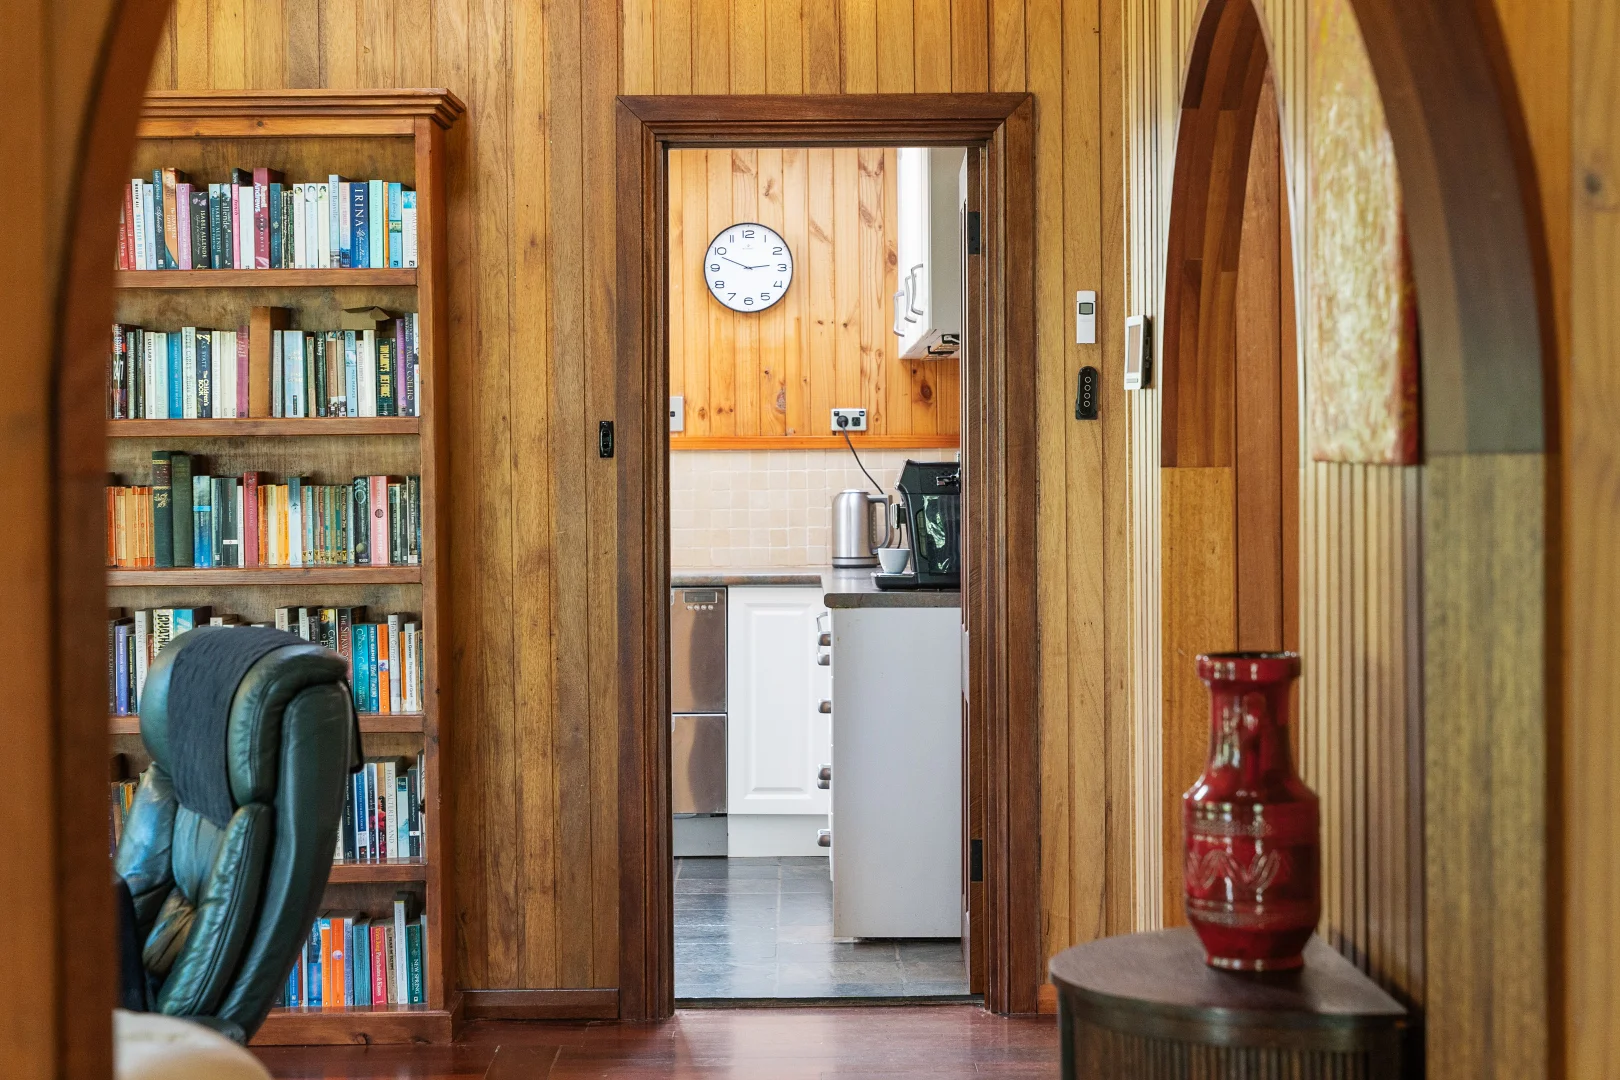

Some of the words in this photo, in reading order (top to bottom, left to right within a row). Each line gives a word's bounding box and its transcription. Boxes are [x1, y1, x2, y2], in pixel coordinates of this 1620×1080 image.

[354, 189, 363, 226] IRINA
[742, 230, 754, 238] 12
[730, 234, 734, 243] 11
[764, 234, 766, 243] 1
[714, 247, 726, 255] 10
[772, 247, 782, 255] 2
[710, 264, 720, 272] 9
[777, 264, 787, 272] 3
[728, 293, 736, 301] 7
[744, 297, 754, 305] 6
[761, 293, 770, 301] 5
[157, 614, 170, 651] JONATHA
[340, 627, 349, 660] SILKWO
